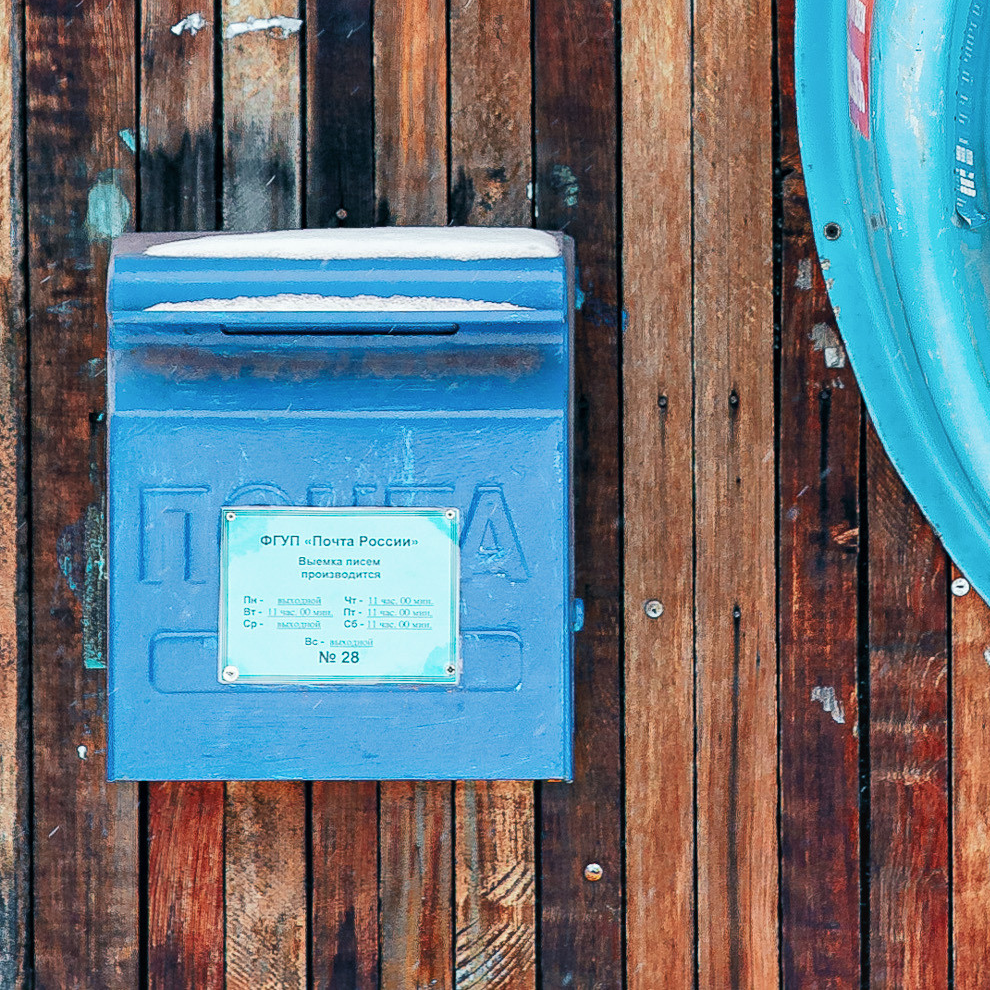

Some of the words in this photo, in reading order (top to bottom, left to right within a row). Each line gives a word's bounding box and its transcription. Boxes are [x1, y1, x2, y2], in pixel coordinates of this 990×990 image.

[260, 535, 300, 547] ФГУП
[304, 536, 354, 547] «Почта
[359, 536, 419, 547] России»
[298, 556, 343, 566] Выемка
[346, 558, 381, 566] писем
[301, 571, 381, 580] производится
[400, 597, 410, 605] 00
[300, 608, 310, 616] 00
[399, 608, 410, 617] 00
[399, 620, 409, 629] 00
[319, 651, 337, 663] №
[342, 652, 360, 663] 28
